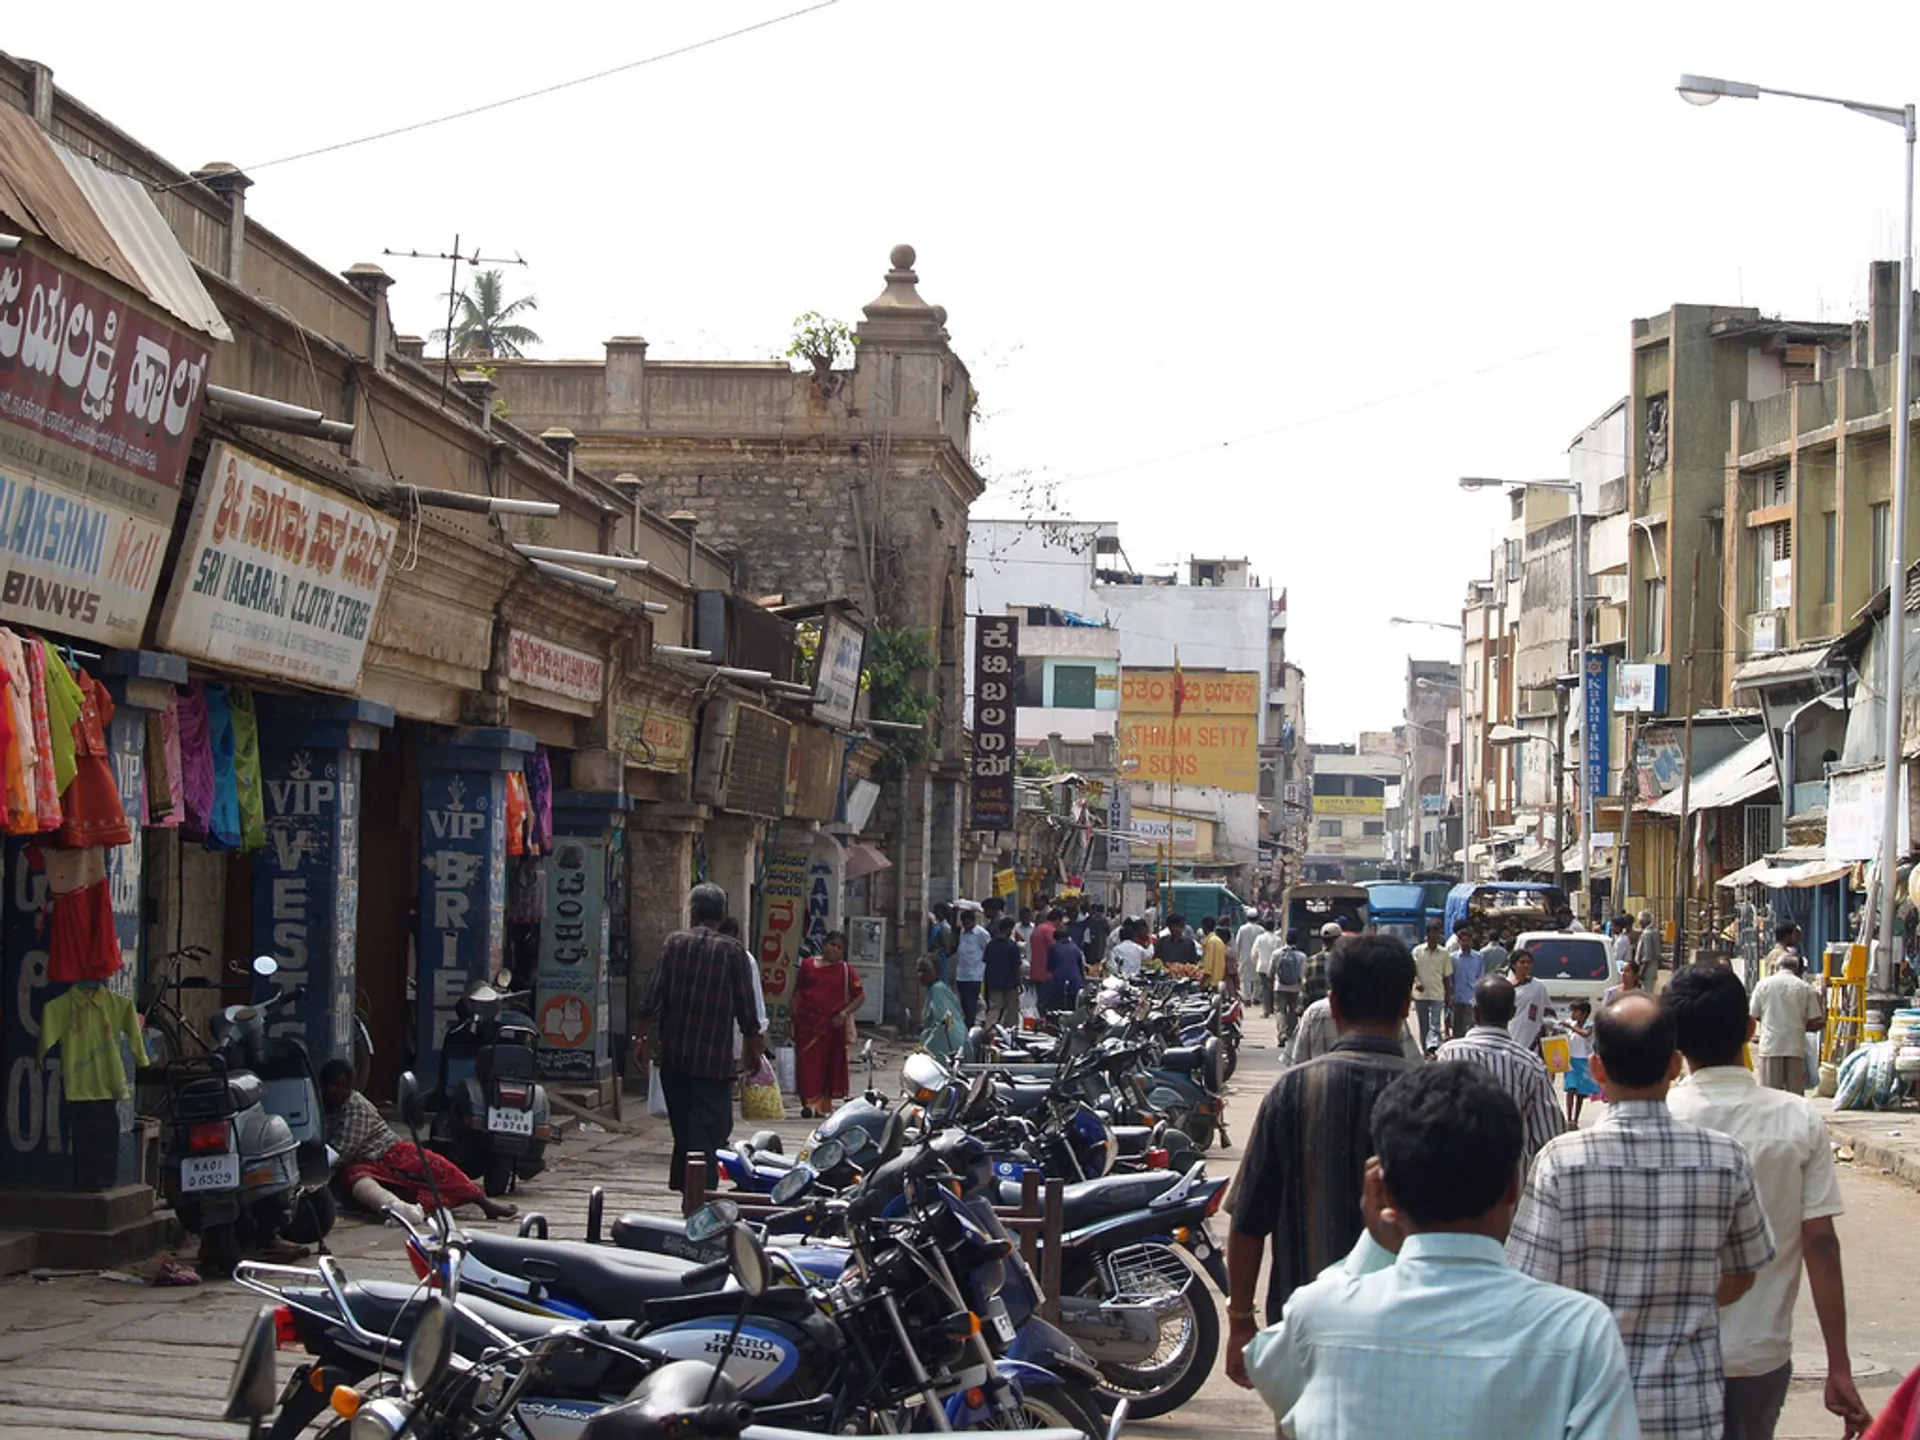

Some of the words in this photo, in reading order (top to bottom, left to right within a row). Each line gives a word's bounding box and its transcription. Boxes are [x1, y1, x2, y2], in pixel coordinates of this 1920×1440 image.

[107, 520, 161, 591] Hall
[192, 547, 227, 598] SRI
[290, 580, 335, 629] CLOTH
[1197, 726, 1249, 748] SETTY
[1148, 754, 1198, 775] SONS
[266, 780, 335, 816] VIP
[427, 810, 485, 840] VIP
[704, 1343, 780, 1363] HONDA
